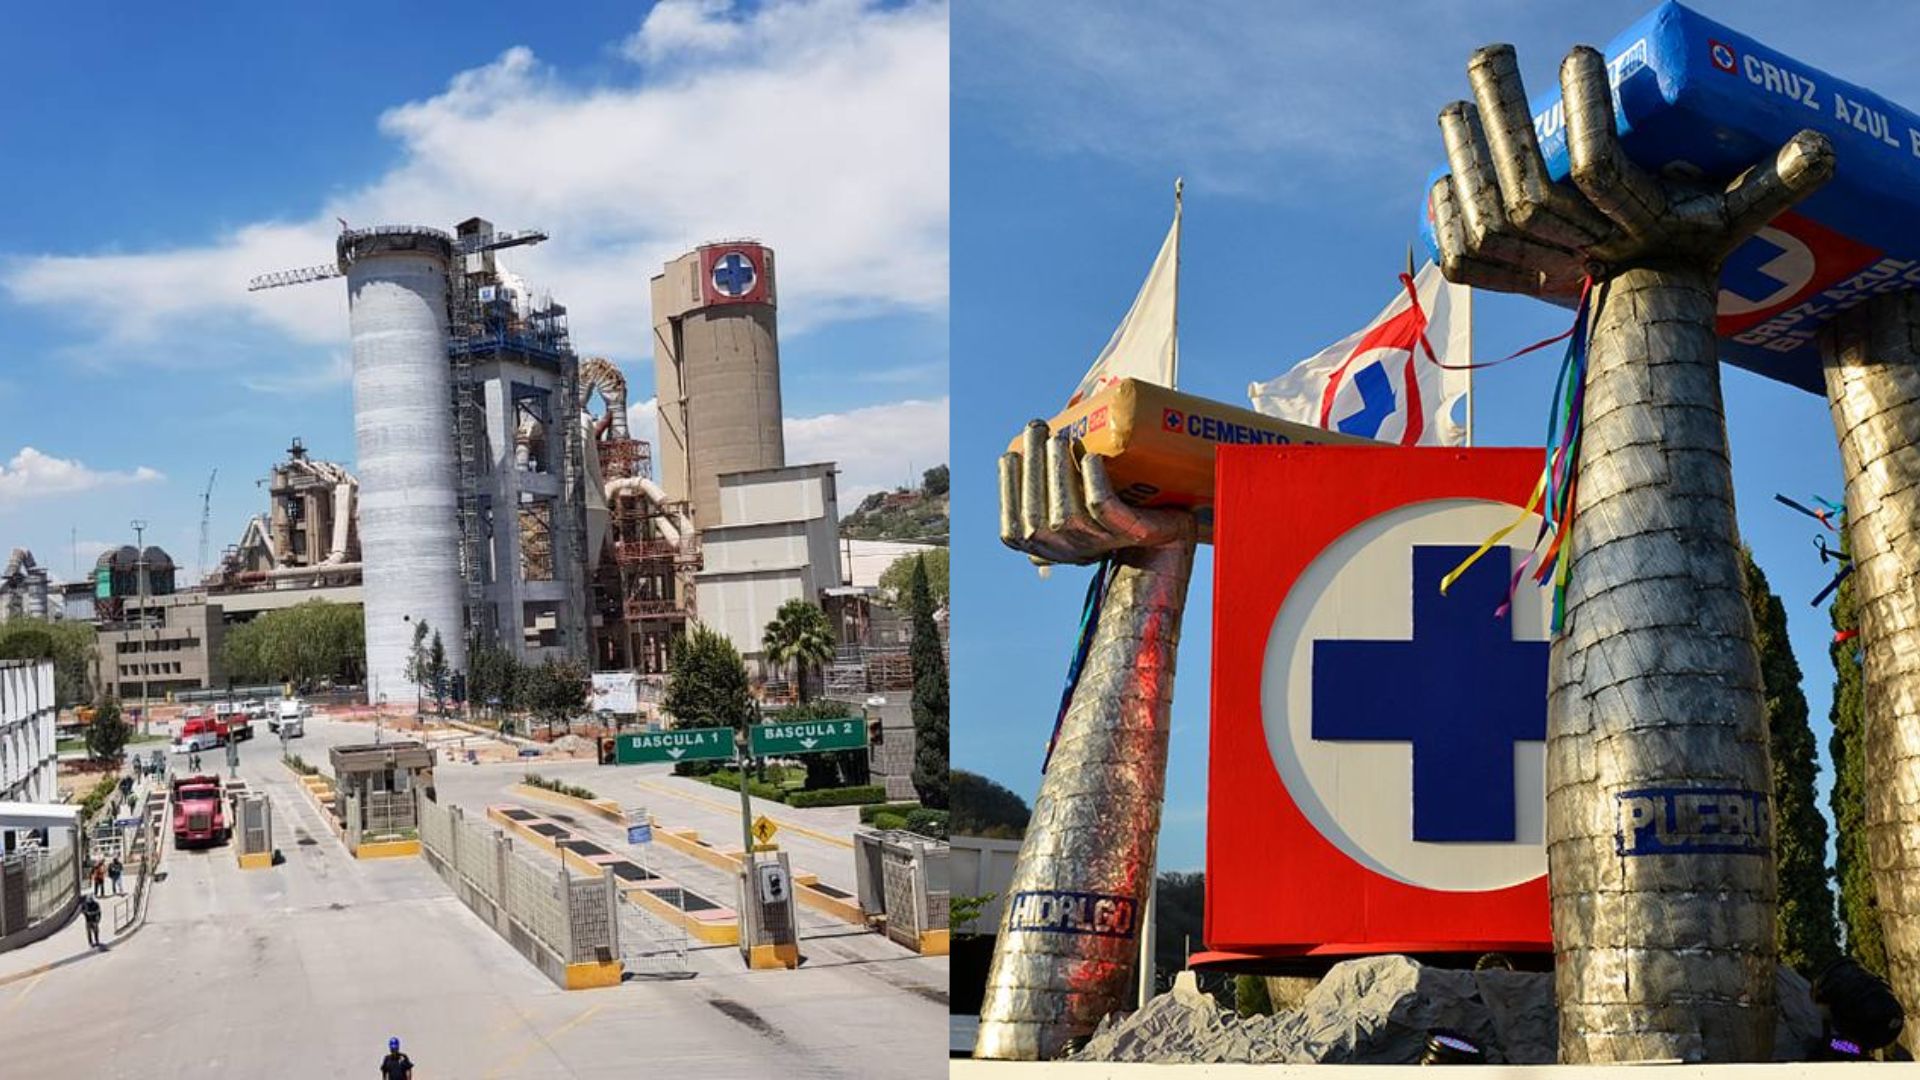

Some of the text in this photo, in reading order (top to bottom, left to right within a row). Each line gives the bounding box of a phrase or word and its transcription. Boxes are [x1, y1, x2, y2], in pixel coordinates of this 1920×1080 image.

[1743, 54, 1820, 111] CRUZ
[1834, 92, 1900, 148] AZUL
[1732, 301, 1829, 345] CRUZ
[1822, 257, 1917, 301] AZUL
[632, 732, 719, 749] BASCULA 1
[764, 722, 853, 740] BASCULA 2
[1011, 894, 1132, 934] HIDALGO
